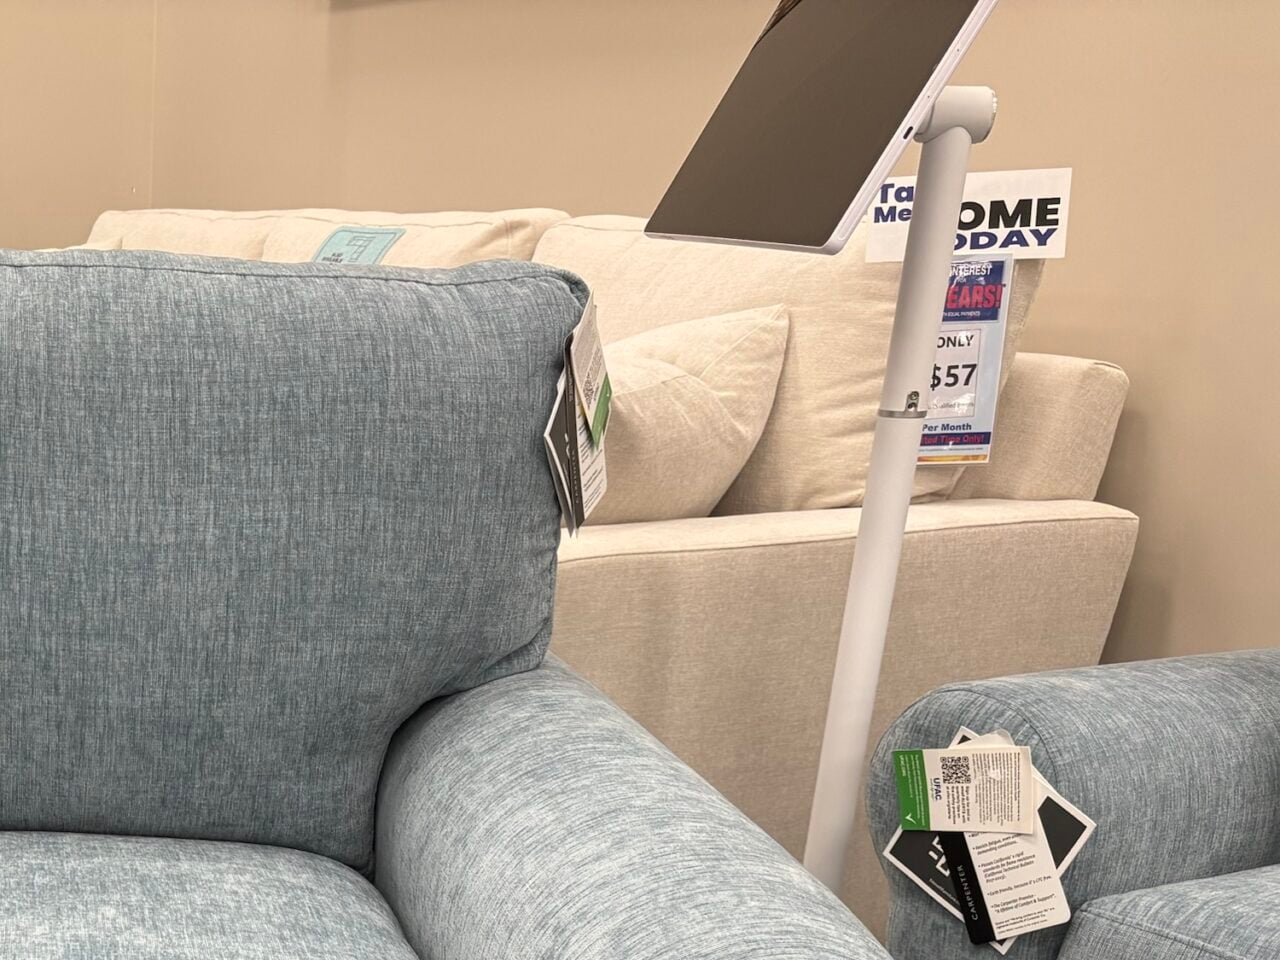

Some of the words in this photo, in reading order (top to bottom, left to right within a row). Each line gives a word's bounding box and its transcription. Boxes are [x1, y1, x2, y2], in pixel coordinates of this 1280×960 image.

[958, 197, 1061, 231] OME
[947, 285, 1002, 309] EARS!
[937, 335, 974, 348] ONLY
[930, 364, 977, 391] $57
[941, 423, 972, 431] Month
[933, 778, 942, 800] UFAC
[957, 865, 978, 920] CARPENTER
